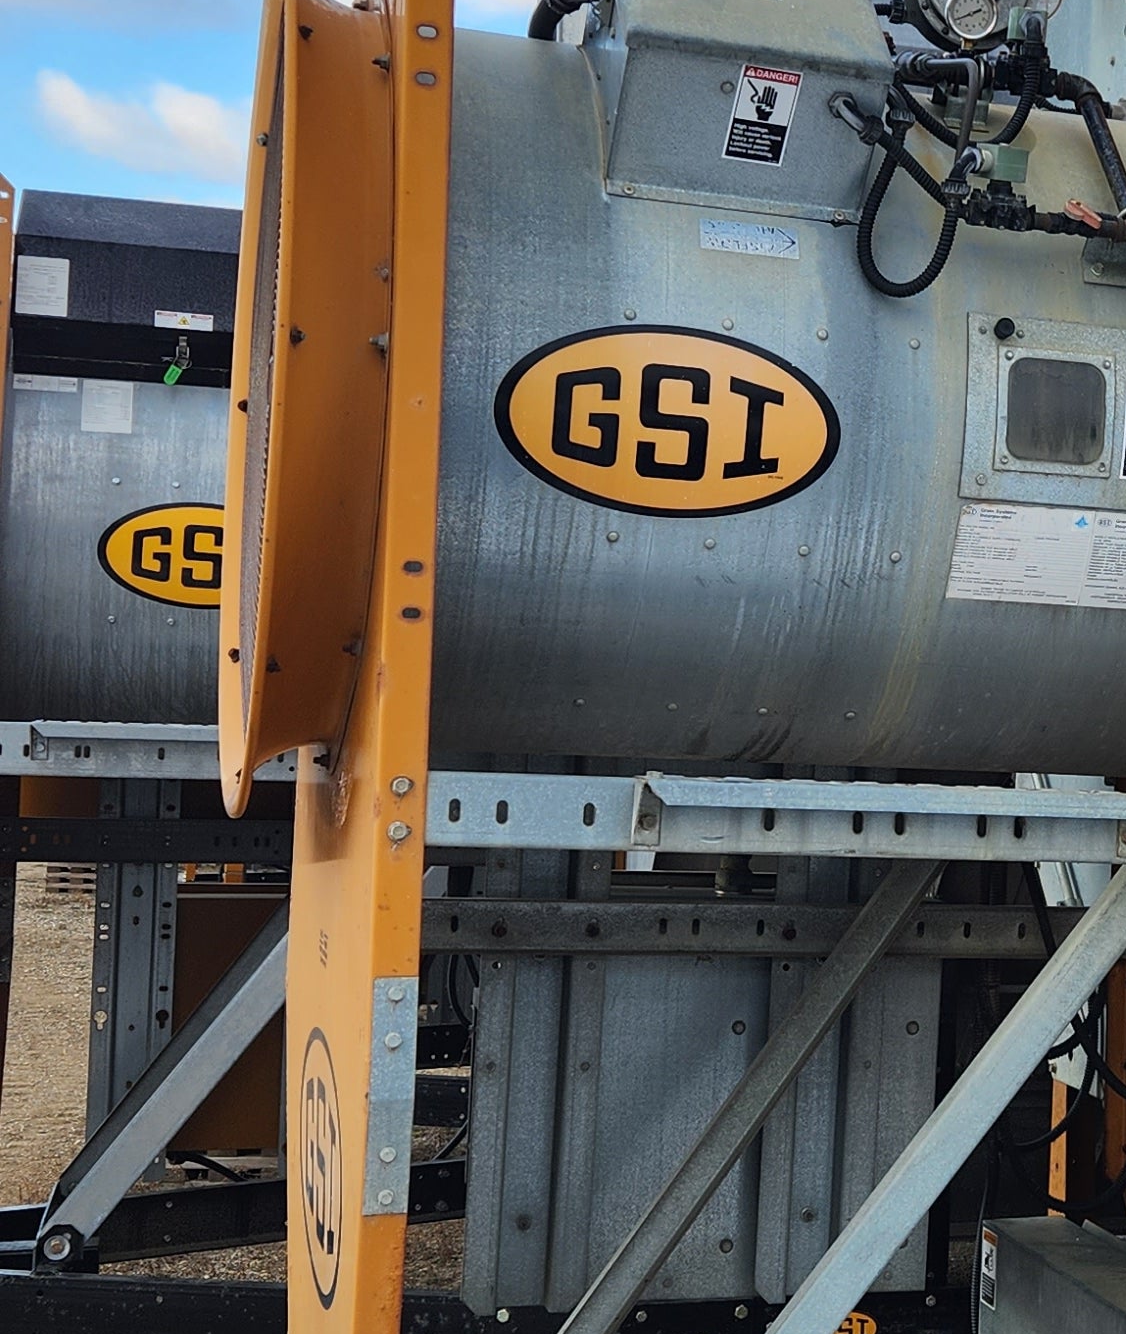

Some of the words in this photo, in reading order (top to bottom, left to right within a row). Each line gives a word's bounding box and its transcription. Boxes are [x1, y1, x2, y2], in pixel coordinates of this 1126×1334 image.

[755, 68, 799, 84] DANGER!
[551, 363, 785, 481] GSI
[131, 525, 224, 589] GS
